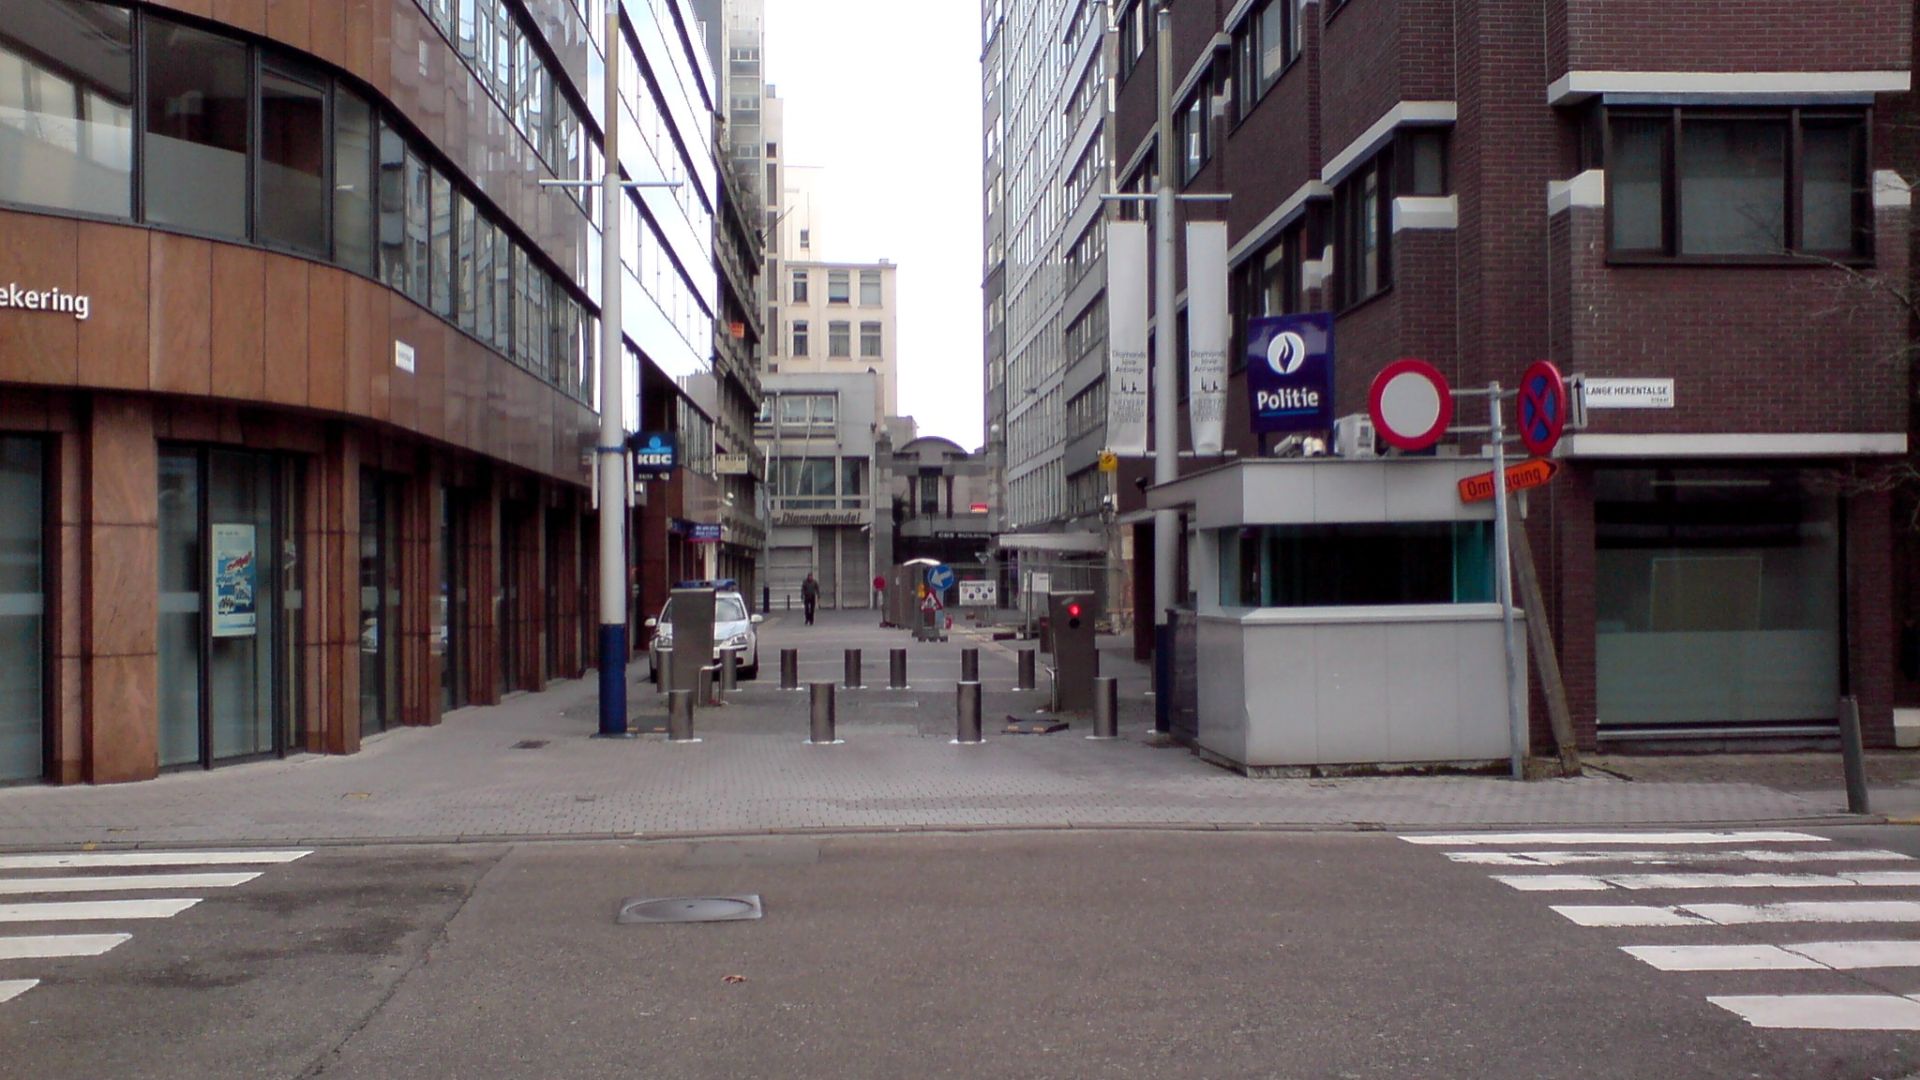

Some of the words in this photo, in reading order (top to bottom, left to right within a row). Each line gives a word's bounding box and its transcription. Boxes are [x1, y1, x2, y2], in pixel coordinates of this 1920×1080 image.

[0, 282, 90, 320] ekering
[1586, 386, 1612, 395] LANGE
[1614, 386, 1668, 395] HERENTALSE
[1257, 387, 1319, 411] Politie
[637, 453, 672, 465] KBC
[782, 511, 861, 523] Diamanthandel
